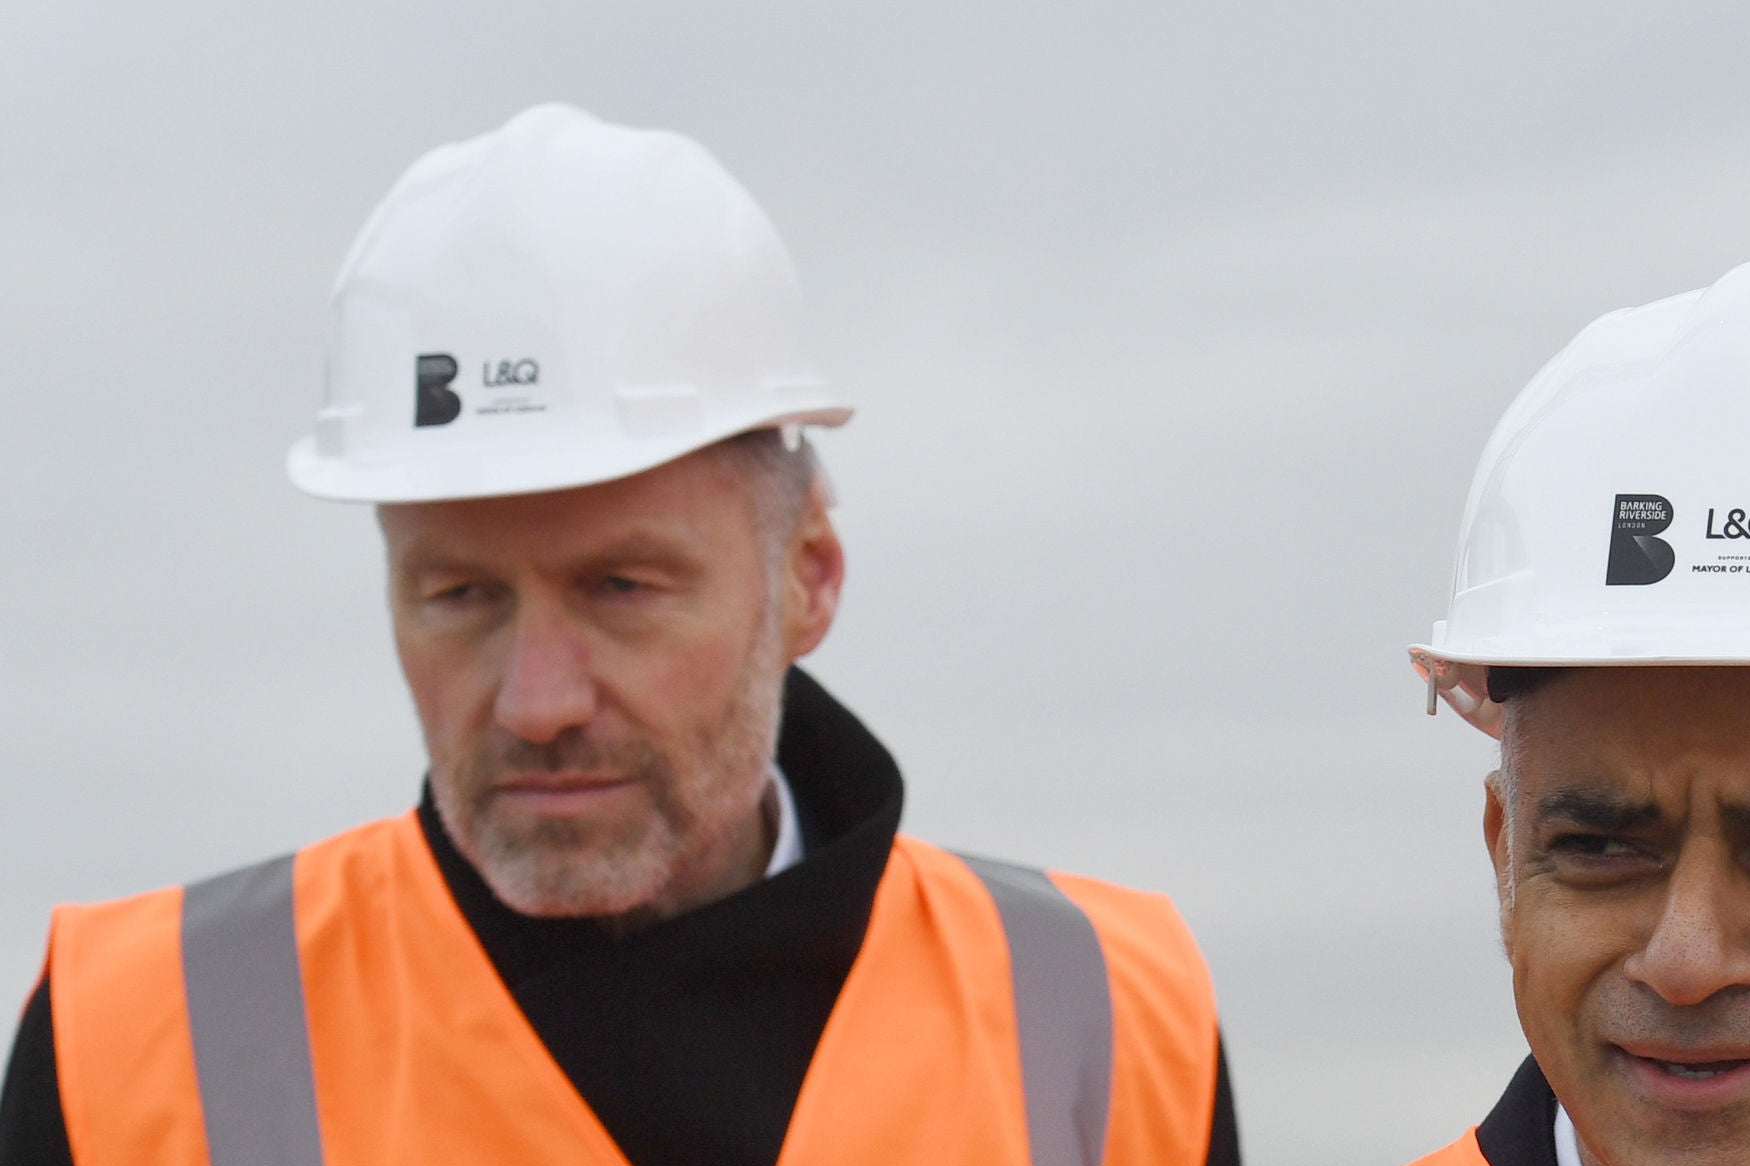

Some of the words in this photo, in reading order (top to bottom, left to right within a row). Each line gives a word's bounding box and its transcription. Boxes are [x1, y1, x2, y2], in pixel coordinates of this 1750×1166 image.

[483, 358, 539, 387] L&Q
[1619, 501, 1663, 511] BARKING
[1619, 510, 1667, 521] RIVERSIDE
[1692, 565, 1727, 573] MAYOR
